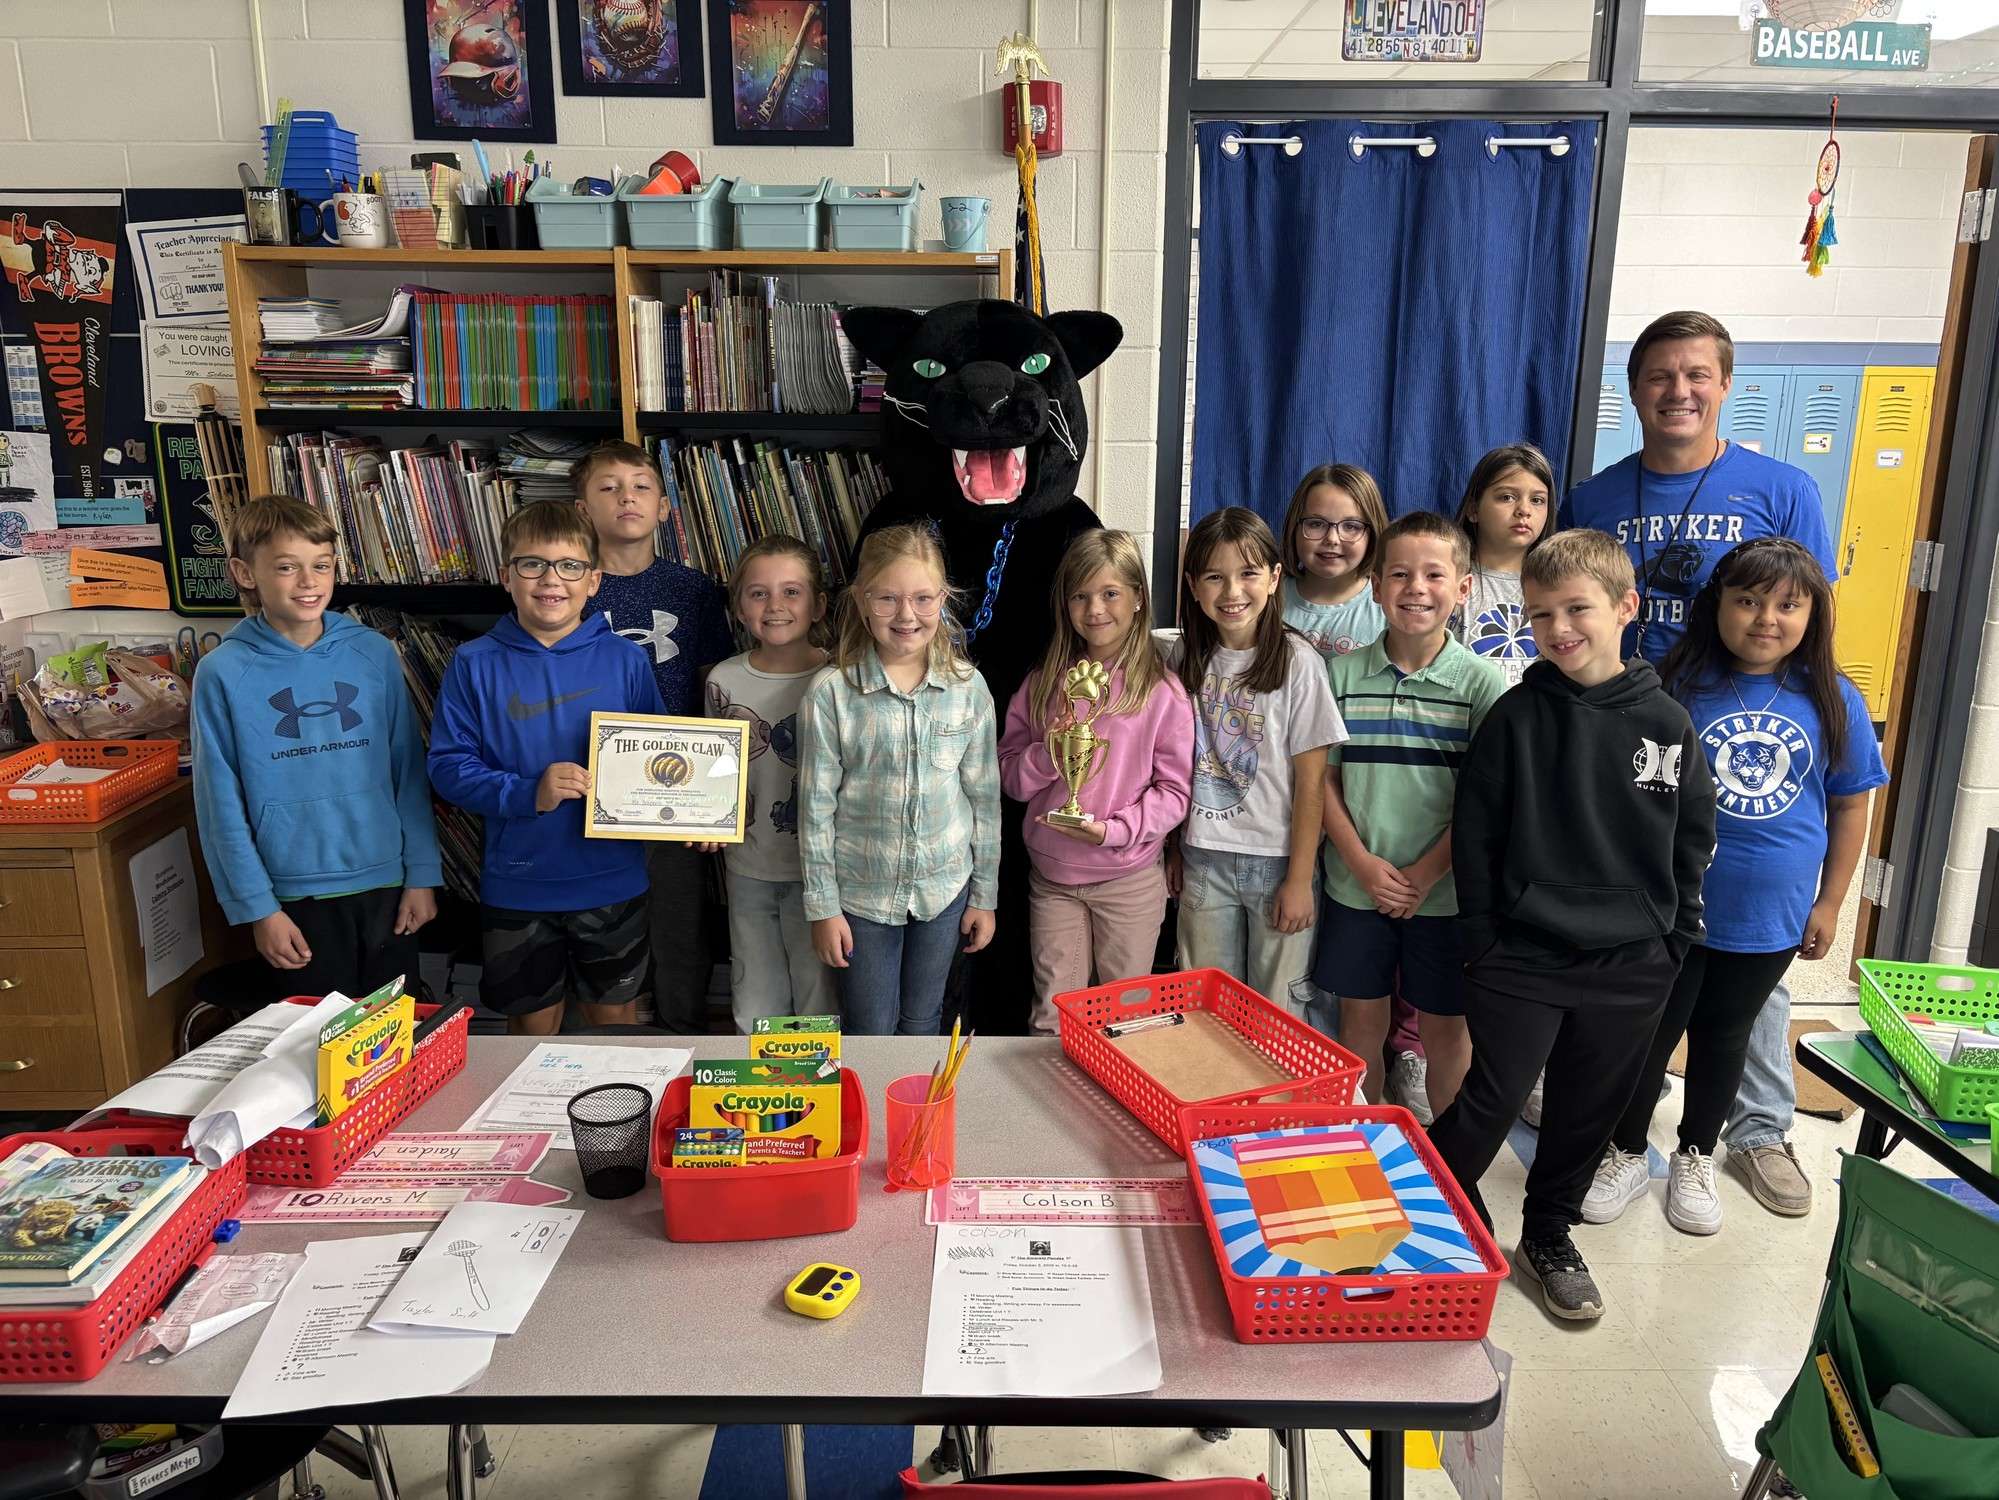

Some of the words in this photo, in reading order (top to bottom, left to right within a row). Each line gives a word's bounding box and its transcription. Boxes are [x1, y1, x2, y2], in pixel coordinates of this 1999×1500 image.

[1757, 26, 1888, 62] BASEBALL
[1891, 49, 1920, 66] AVE
[154, 236, 187, 251] Teacher
[188, 234, 240, 246] Appreciati
[185, 284, 208, 294] THANK
[158, 331, 176, 341] You
[177, 333, 198, 341] were
[200, 334, 228, 344] caught
[83, 317, 101, 388] Cleveland
[181, 344, 235, 358] LOVING!
[34, 321, 88, 446] BROWNS
[1616, 513, 1744, 545] STRYKER
[184, 579, 237, 599] FANS
[1705, 716, 1806, 753] STRYKER
[271, 745, 318, 761] UNDER
[319, 738, 370, 753] ARMOUR
[614, 738, 640, 754] THE
[642, 739, 689, 753] GOLDEN
[691, 742, 725, 757] CLAW
[1636, 782, 1677, 794] HURLEY
[756, 1019, 770, 1032] 12
[320, 1028, 332, 1045] 10
[352, 1018, 399, 1057] Crayola
[764, 1039, 824, 1055] Crayola
[695, 1068, 713, 1084] 10
[714, 1068, 737, 1077] Classic
[714, 1076, 737, 1084] Colors
[722, 1092, 805, 1114] Crayola
[679, 1132, 693, 1141] 24
[745, 1139, 764, 1149] rand
[765, 1139, 805, 1150] Preferred
[778, 1148, 806, 1156] Teachers
[682, 1159, 732, 1168] Crayola
[324, 1190, 393, 1206] Rivers
[1022, 1192, 1093, 1207] Colson
[139, 1469, 170, 1489] Rivers
[170, 1455, 199, 1475] Meyer
